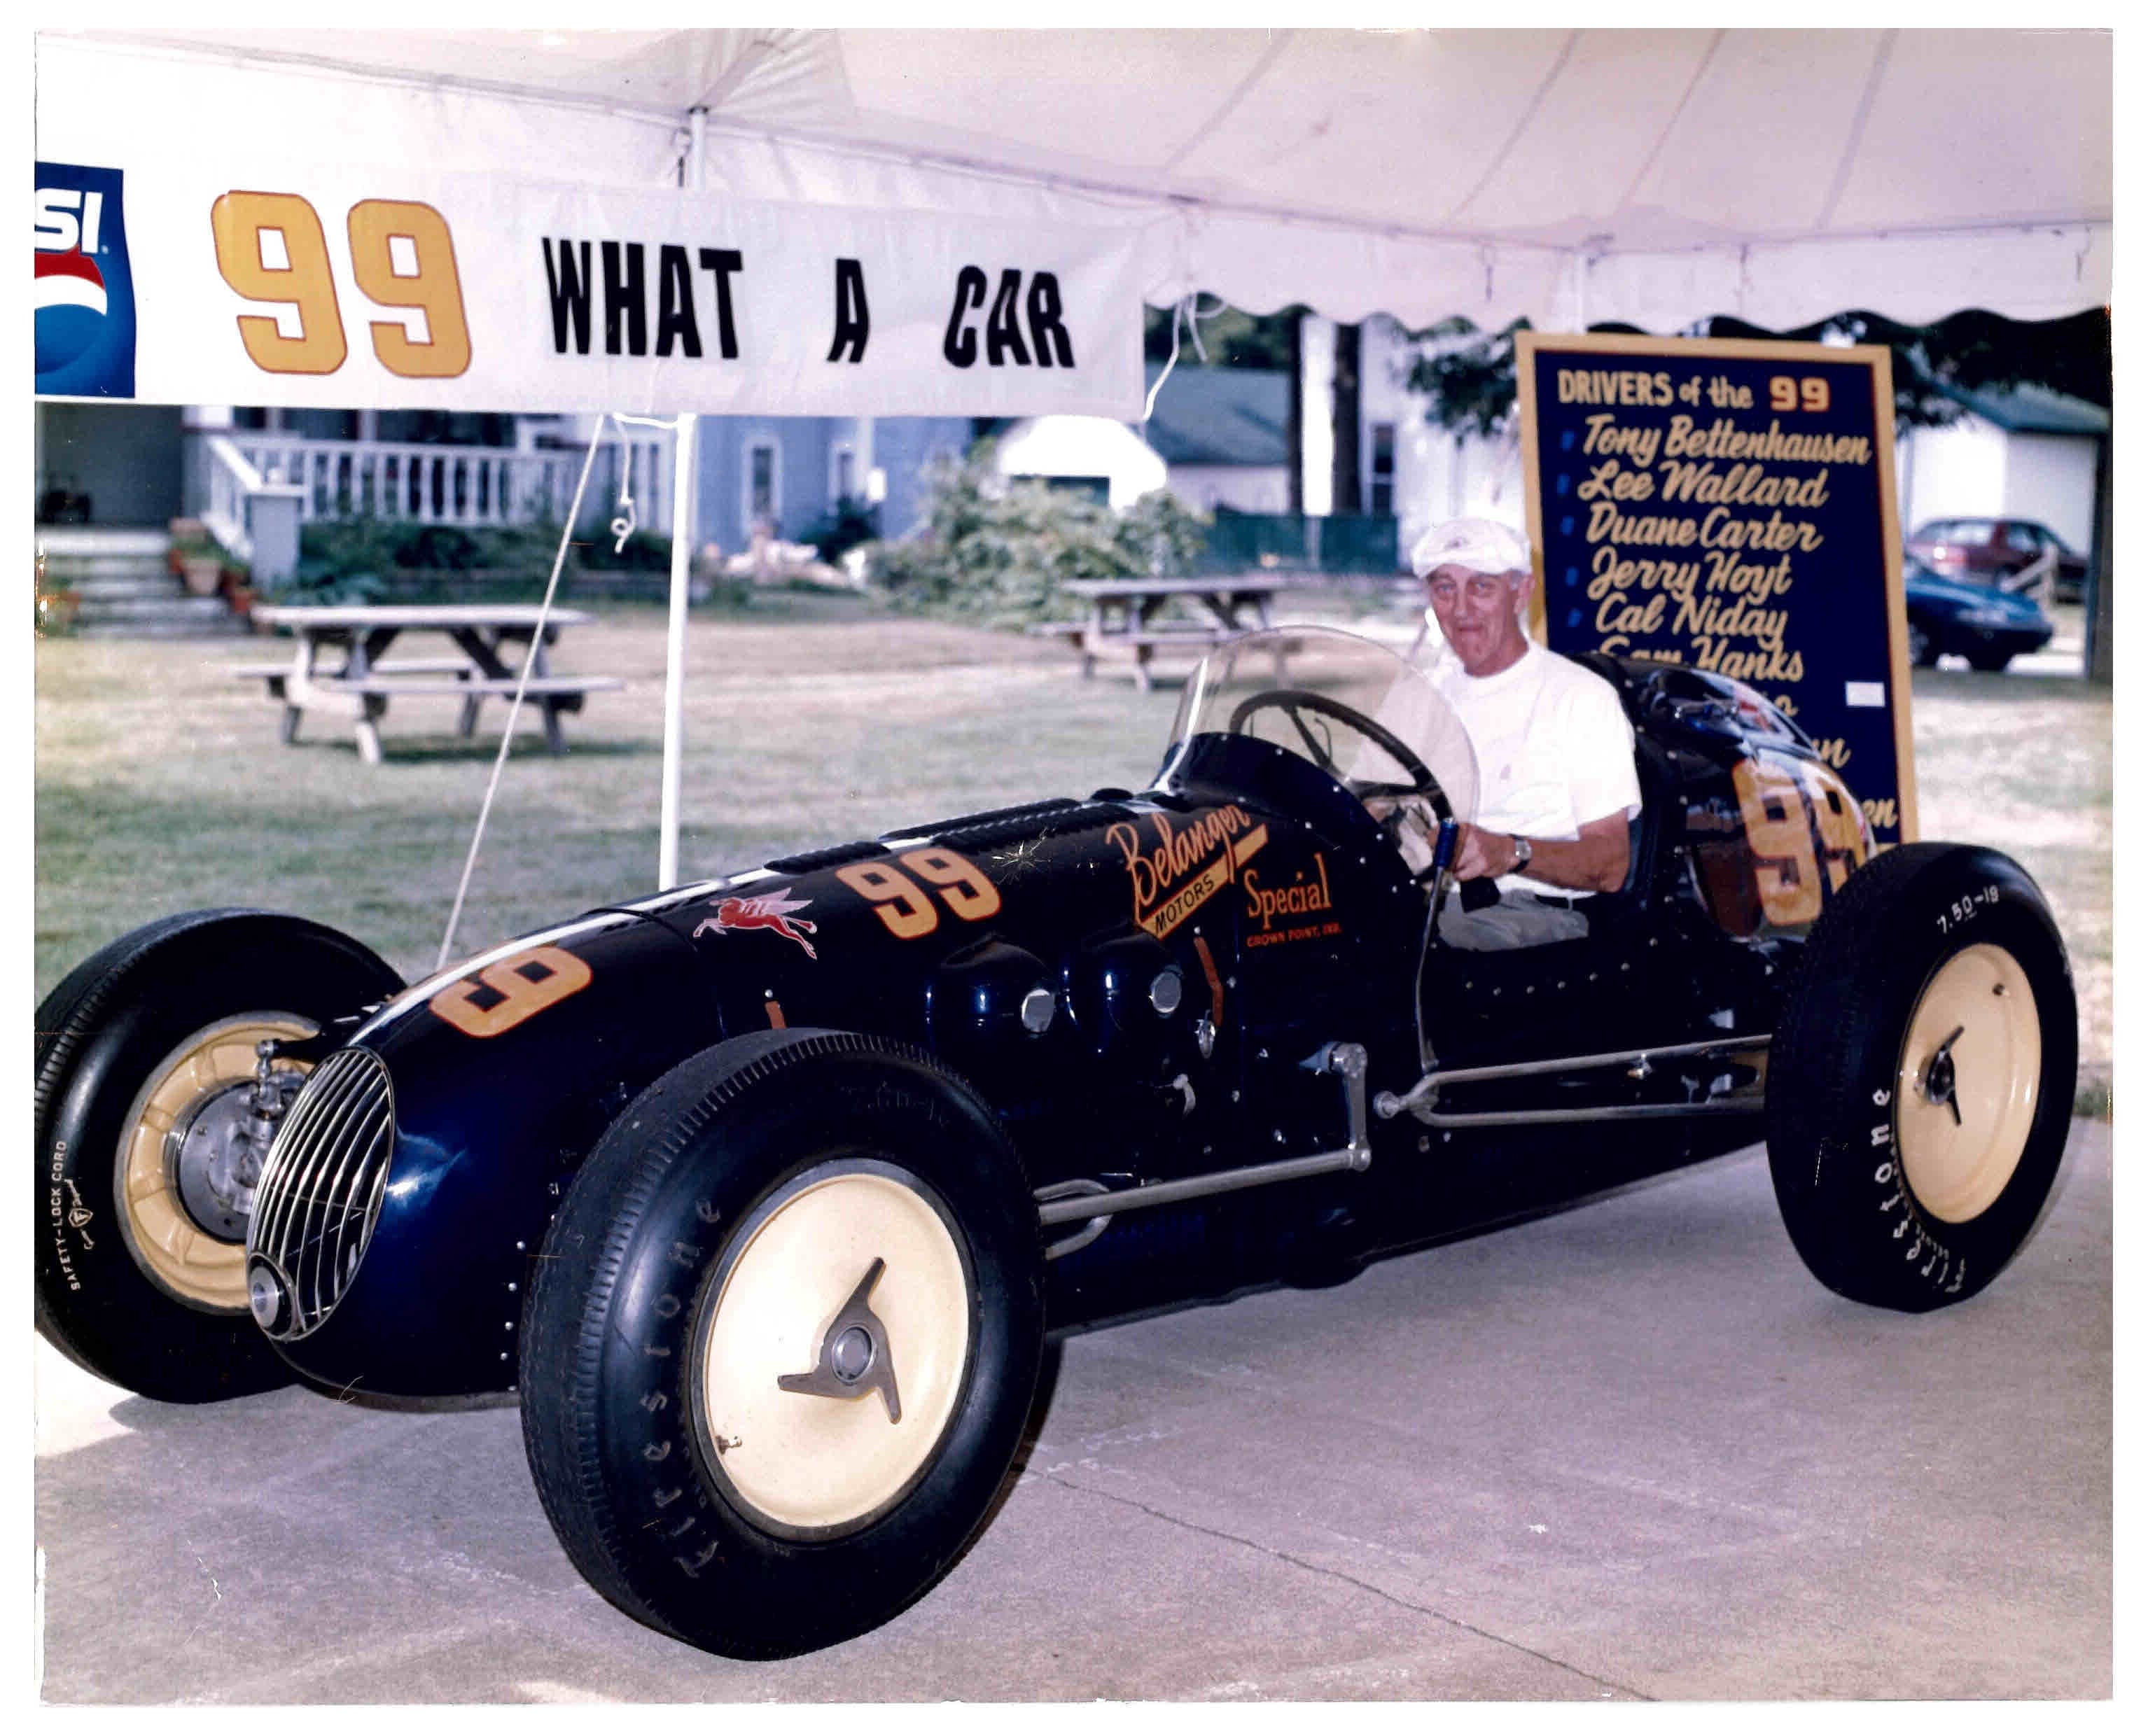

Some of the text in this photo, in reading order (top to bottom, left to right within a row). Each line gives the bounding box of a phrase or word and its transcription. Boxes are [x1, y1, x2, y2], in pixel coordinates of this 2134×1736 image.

[210, 189, 1075, 379] 99 WHAT A CAR
[1558, 369, 1830, 412] DRIVERS of the 99
[1582, 414, 1874, 468] Tony Bettenhausen
[1577, 458, 1829, 507] Lee Wallard
[1585, 500, 1825, 552] Duane Carter
[1586, 545, 1794, 606] Jerry Hoyt
[1595, 591, 1789, 651] Cal Niday
[1690, 635, 1806, 682] Hanks
[1105, 804, 1251, 923] Belanger
[1731, 756, 1868, 927] 99
[837, 846, 1003, 941] 99
[1154, 874, 1216, 934] MOTORS
[1243, 853, 1332, 930] Special
[50, 1140, 81, 1291] SAFETY-LOCK CORD
[1870, 1088, 1967, 1293] Firestone
[637, 1196, 721, 1579] Firestone
